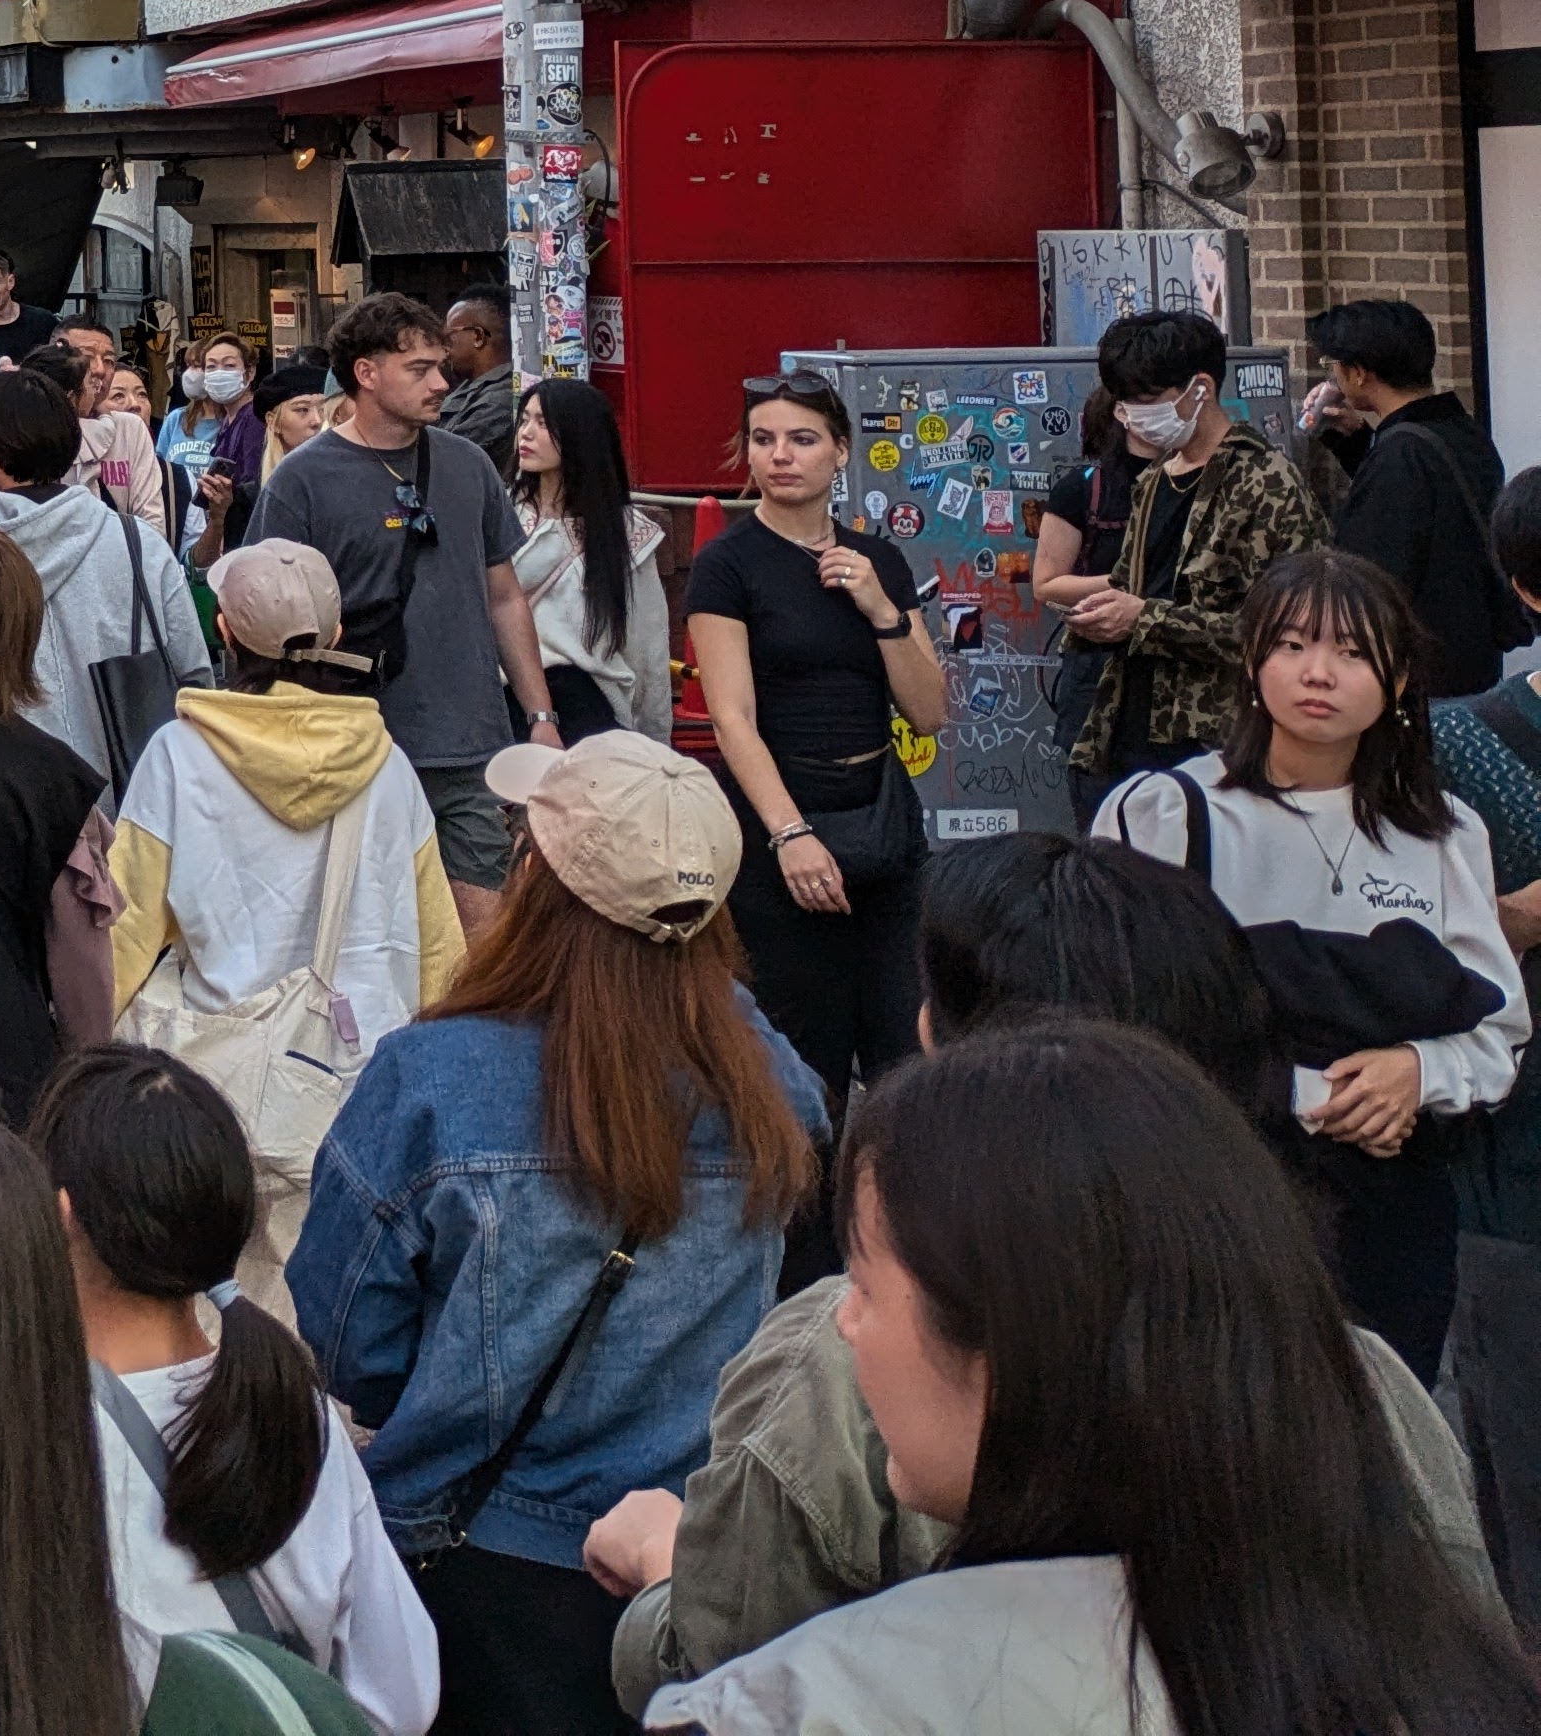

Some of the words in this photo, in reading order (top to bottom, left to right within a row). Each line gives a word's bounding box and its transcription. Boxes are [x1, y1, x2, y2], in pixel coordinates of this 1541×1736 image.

[190, 317, 225, 327] YELLOW
[238, 324, 267, 334] YELLOW
[1236, 364, 1284, 392] 2MUCH
[926, 443, 963, 457] ROLLING
[930, 452, 963, 464] DEATH
[948, 816, 1008, 832] 原立586
[677, 871, 715, 887] POLO
